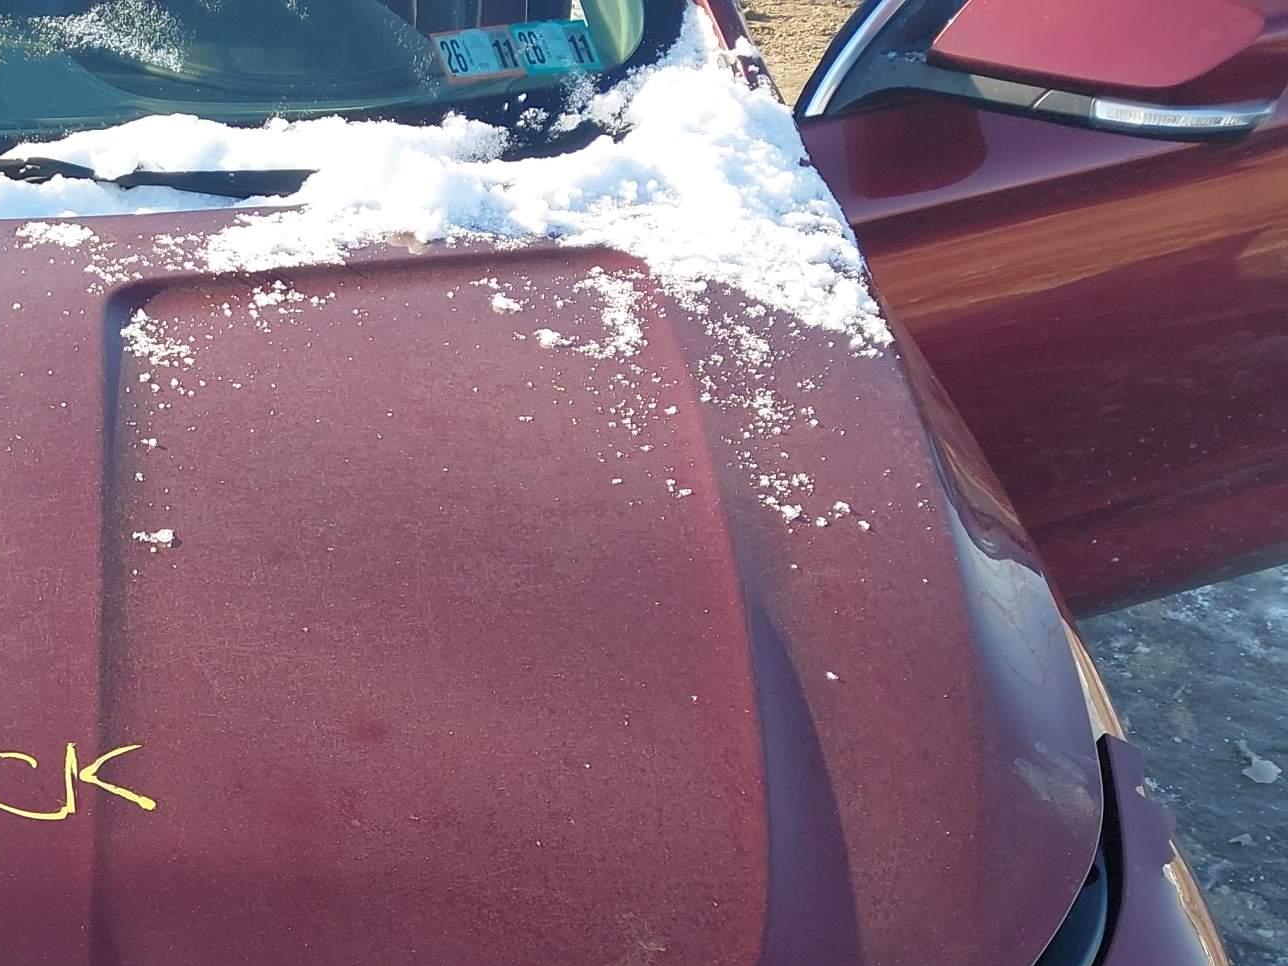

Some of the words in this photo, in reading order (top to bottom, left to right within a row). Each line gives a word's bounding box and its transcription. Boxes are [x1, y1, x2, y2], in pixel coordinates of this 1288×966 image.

[439, 39, 469, 74] 26
[492, 38, 519, 69] 11
[518, 30, 547, 65] 26
[567, 33, 595, 64] 11
